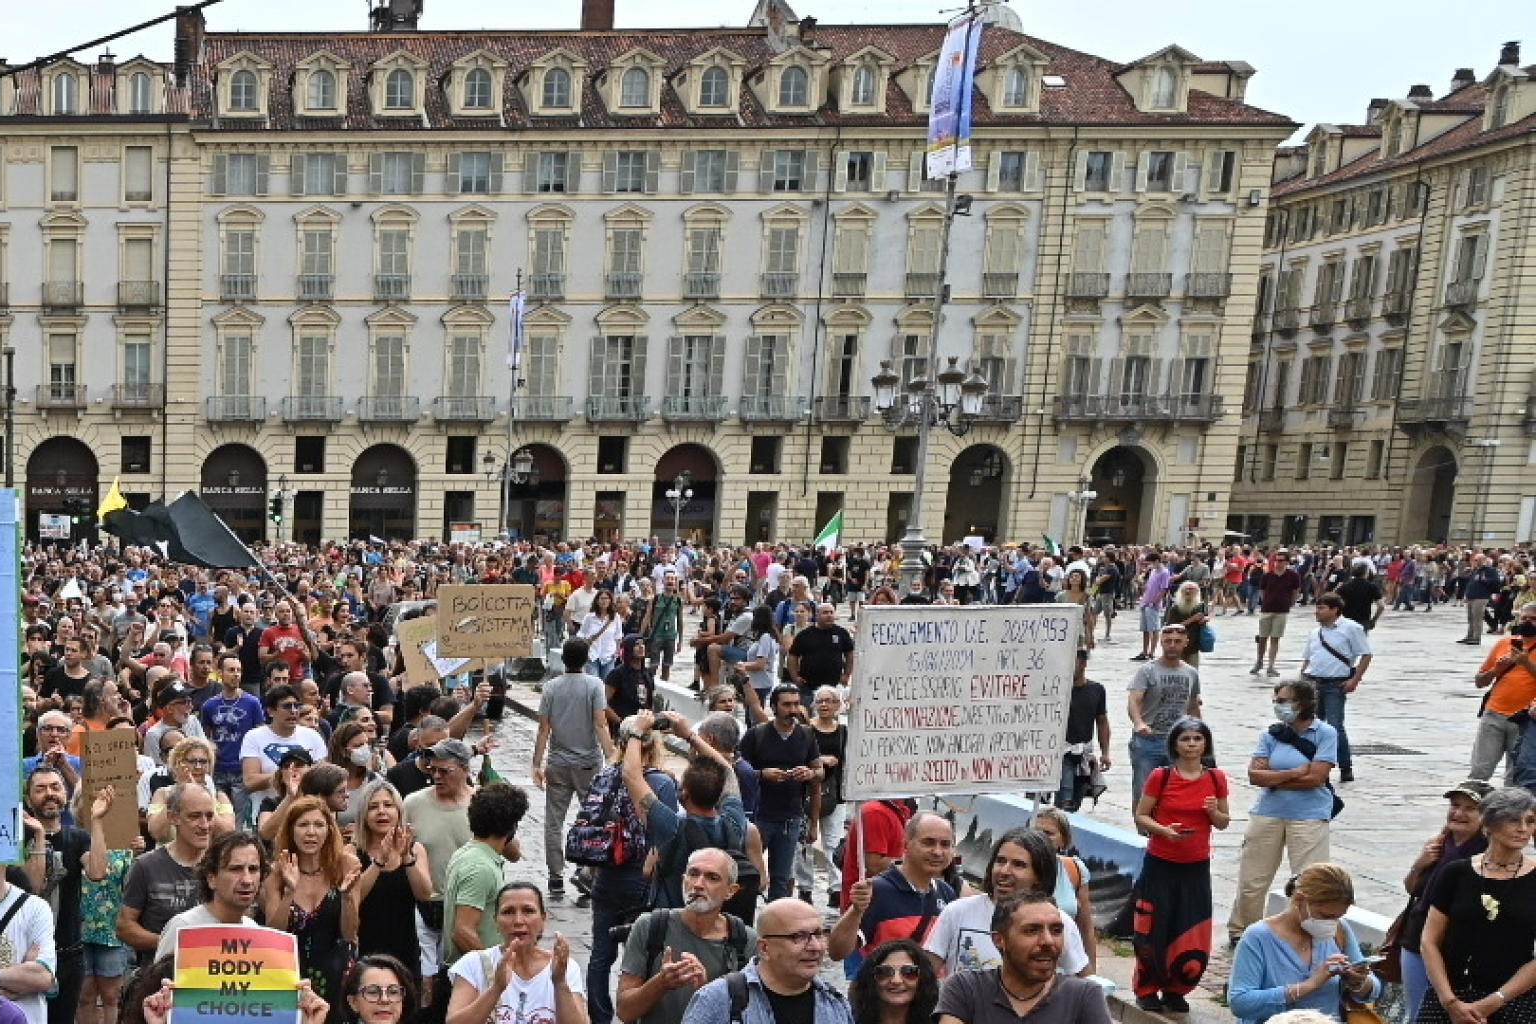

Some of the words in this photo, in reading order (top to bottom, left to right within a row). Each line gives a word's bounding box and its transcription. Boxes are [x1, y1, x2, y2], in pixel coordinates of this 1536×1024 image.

[871, 619, 959, 646] REGOLAMENTO
[1025, 648, 1046, 671] 36
[969, 674, 1031, 699] EVITARE
[1040, 674, 1061, 697] LA
[921, 759, 959, 783] SCELTO
[972, 757, 993, 781] NON
[220, 938, 253, 955] MY
[207, 959, 265, 976] BODY
[219, 981, 251, 997] MY
[196, 1000, 274, 1017] CHOICE
